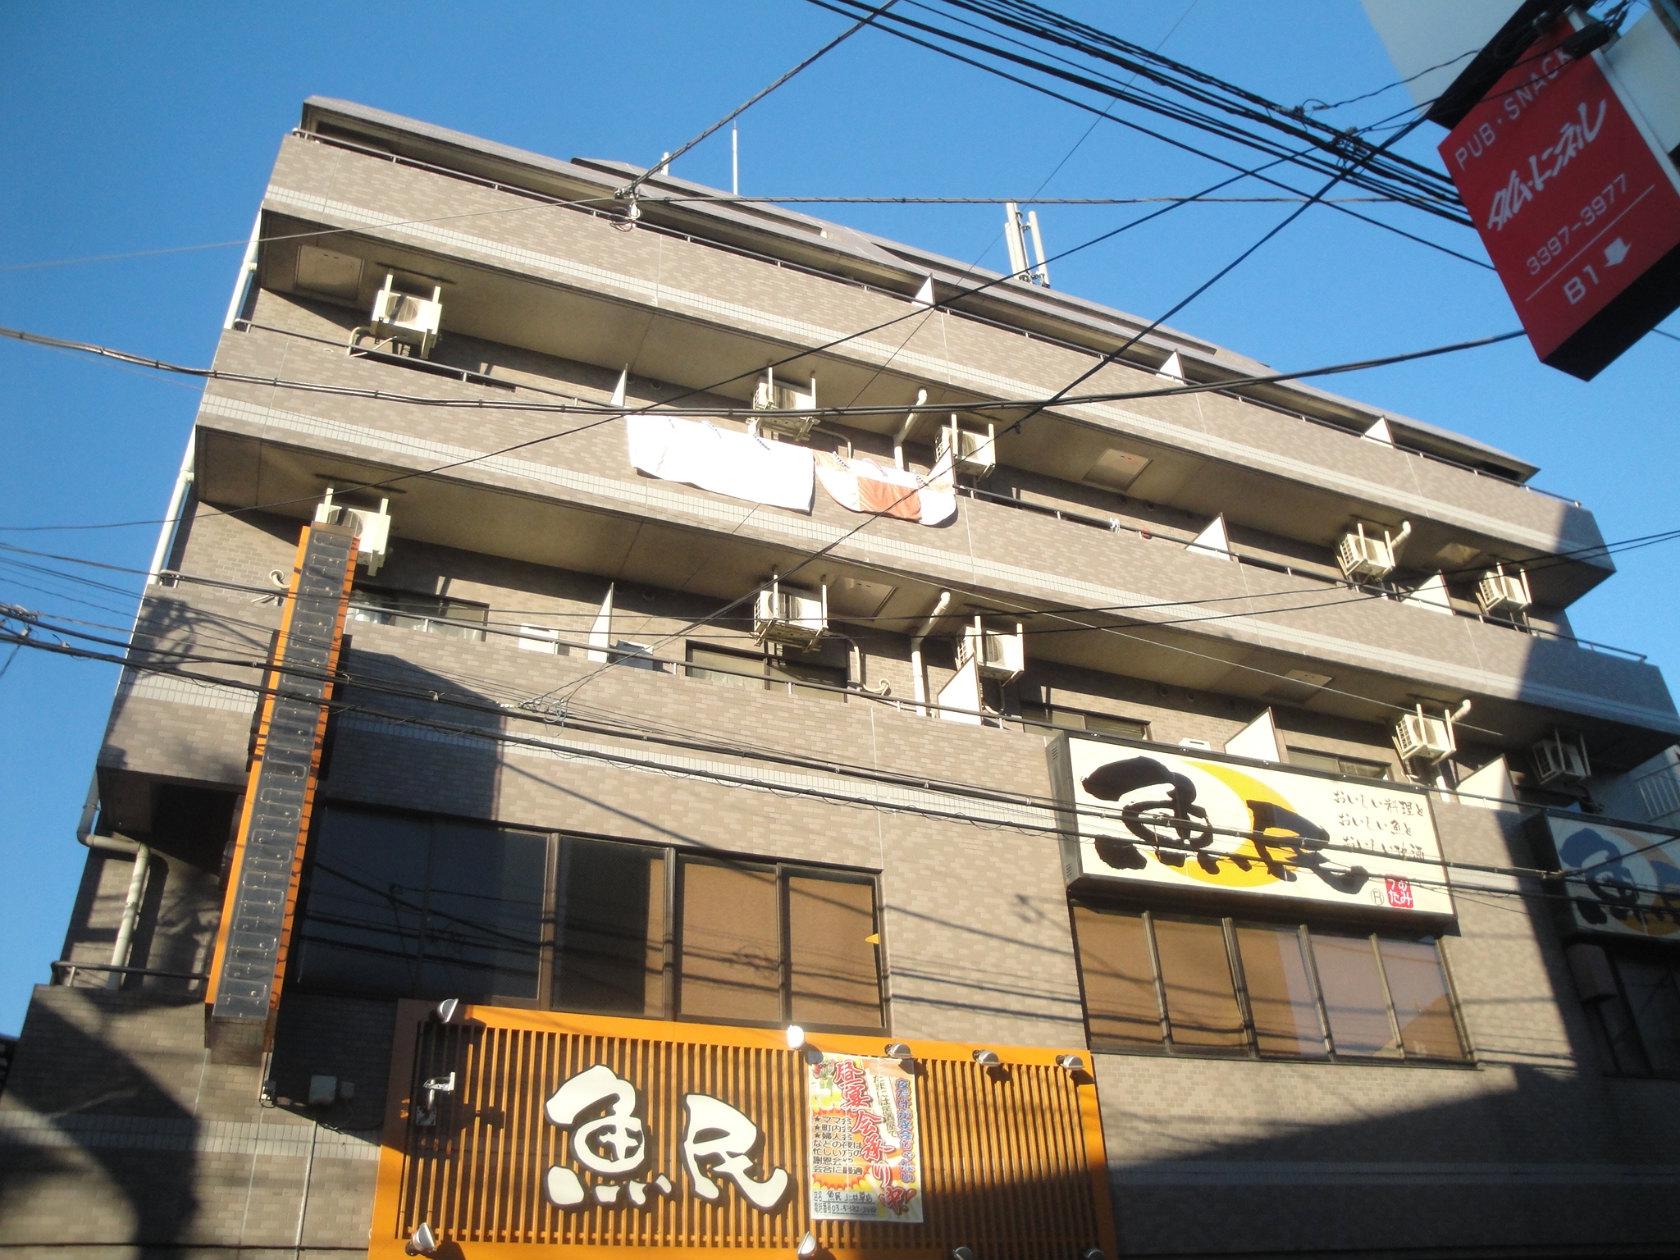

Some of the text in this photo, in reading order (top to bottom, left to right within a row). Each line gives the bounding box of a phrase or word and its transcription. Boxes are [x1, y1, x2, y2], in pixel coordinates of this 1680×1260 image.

[1526, 172, 1627, 275] 3397-3977
[1563, 264, 1599, 304] B1
[1080, 755, 1370, 895] 魚民
[545, 1063, 789, 1209] 魚民
